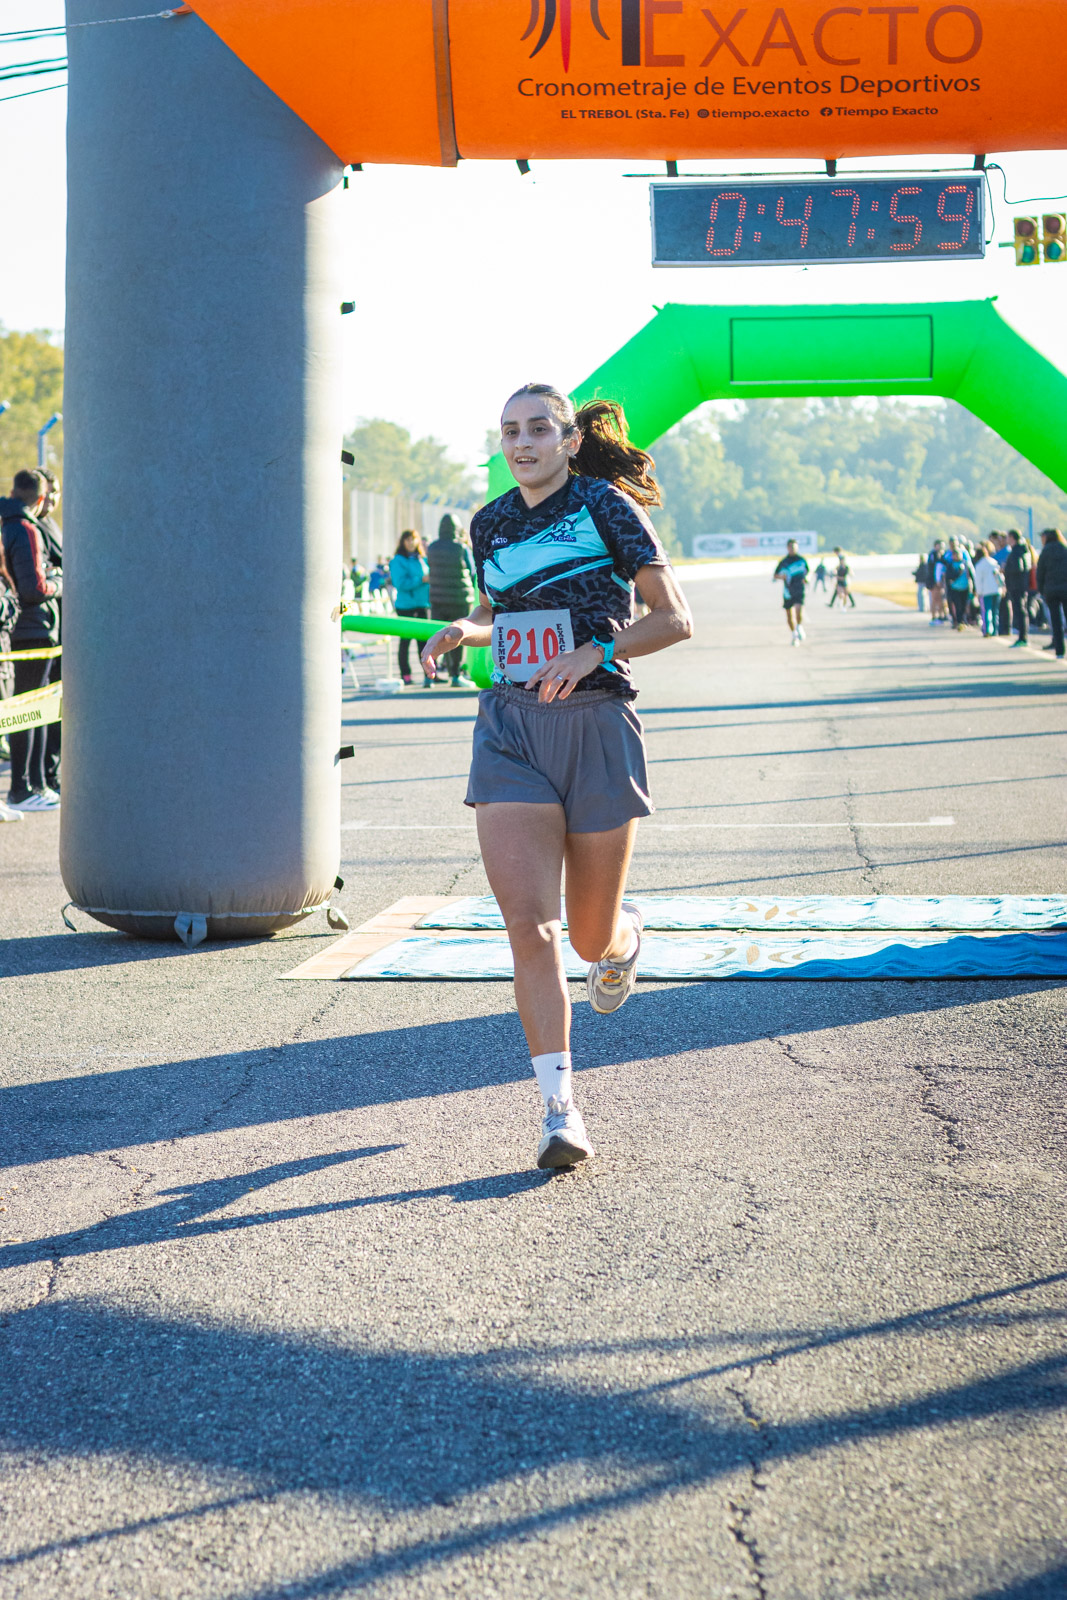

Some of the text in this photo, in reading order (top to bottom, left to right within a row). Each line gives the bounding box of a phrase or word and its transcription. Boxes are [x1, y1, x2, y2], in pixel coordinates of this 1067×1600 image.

[517, 74, 981, 100] Cronometraje de Eventos Deportivos
[561, 105, 939, 121] EL TREBOL (Sta. Fe) tiempo.exacto Tiempo Exacto
[705, 185, 975, 256] 0:47:59
[497, 626, 506, 670] TIEMPO
[506, 627, 559, 665] 210
[556, 623, 566, 654] EXAC
[0, 710, 42, 728] ECAUCION
